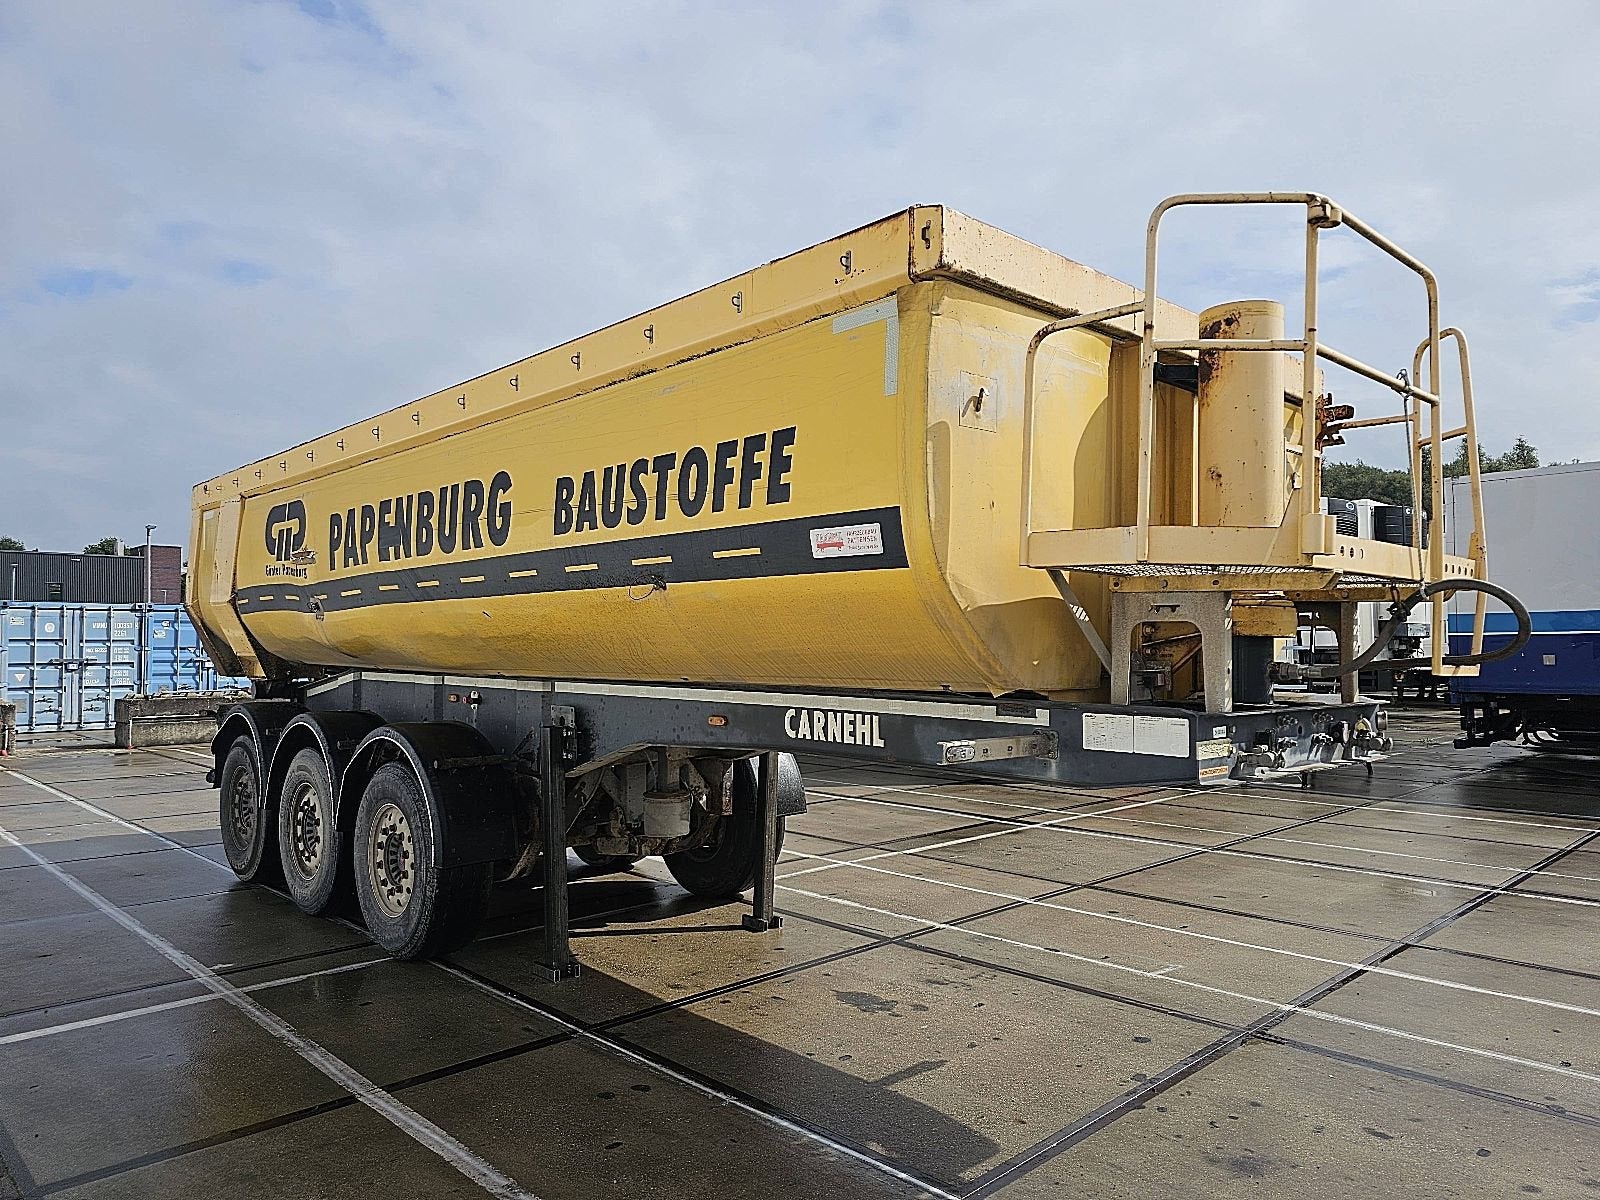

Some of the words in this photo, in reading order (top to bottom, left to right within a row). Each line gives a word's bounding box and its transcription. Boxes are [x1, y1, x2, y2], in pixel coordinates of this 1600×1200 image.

[329, 470, 512, 571] PAPENBURG
[553, 426, 796, 535] BAUSTOFFE
[784, 708, 886, 749] CARNEHL
